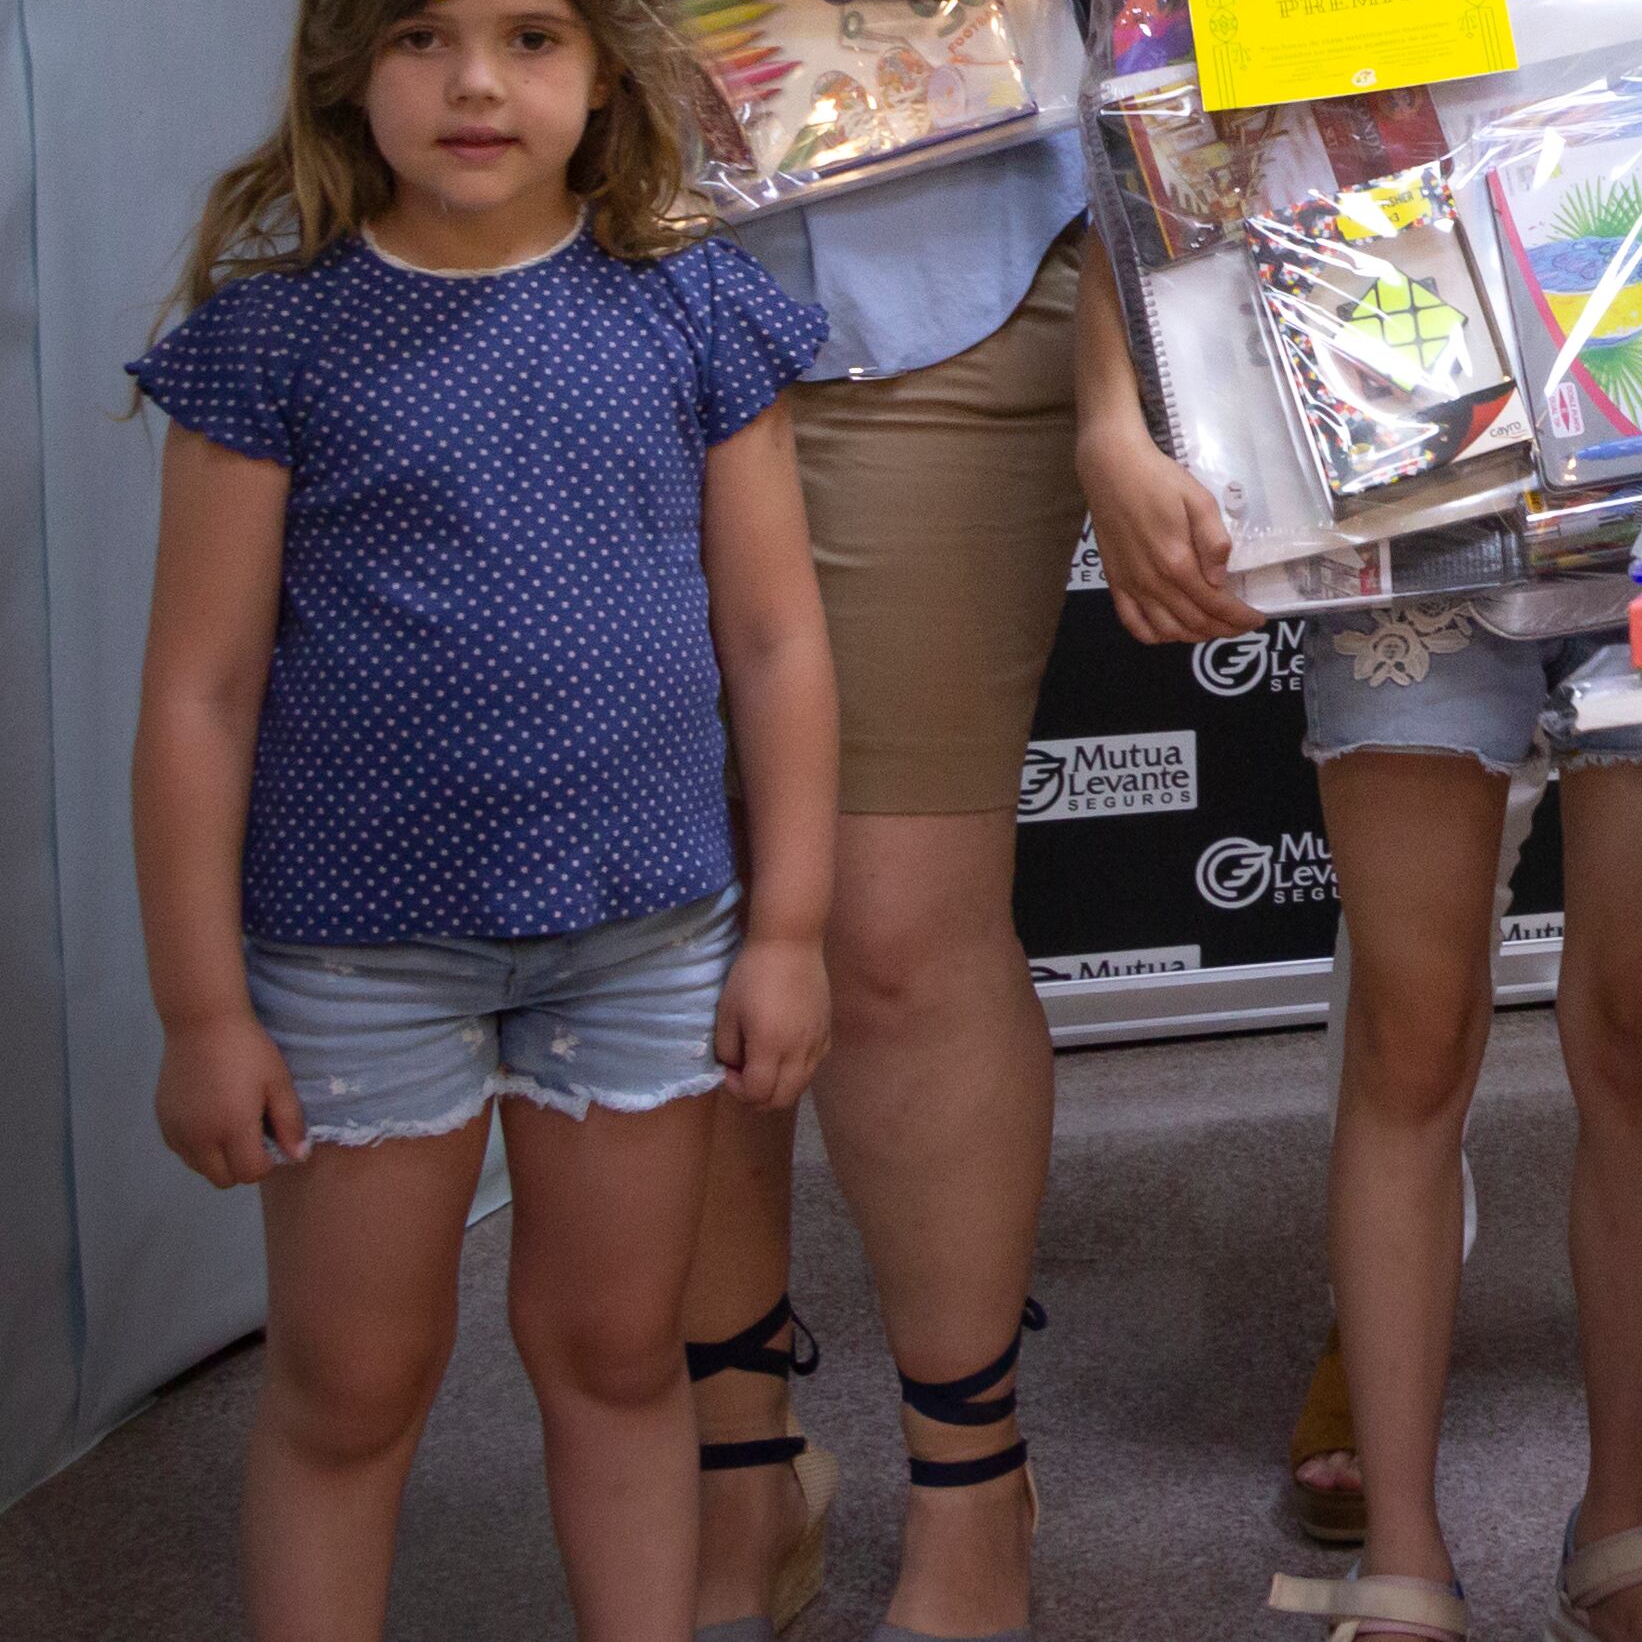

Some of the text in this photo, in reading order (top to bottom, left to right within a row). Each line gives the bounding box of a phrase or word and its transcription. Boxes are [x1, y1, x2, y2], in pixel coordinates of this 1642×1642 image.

[1490, 421, 1521, 438] cayro
[1072, 744, 1182, 771] Mutua
[1069, 768, 1189, 793] Levante
[1068, 791, 1191, 811] SEGUROS
